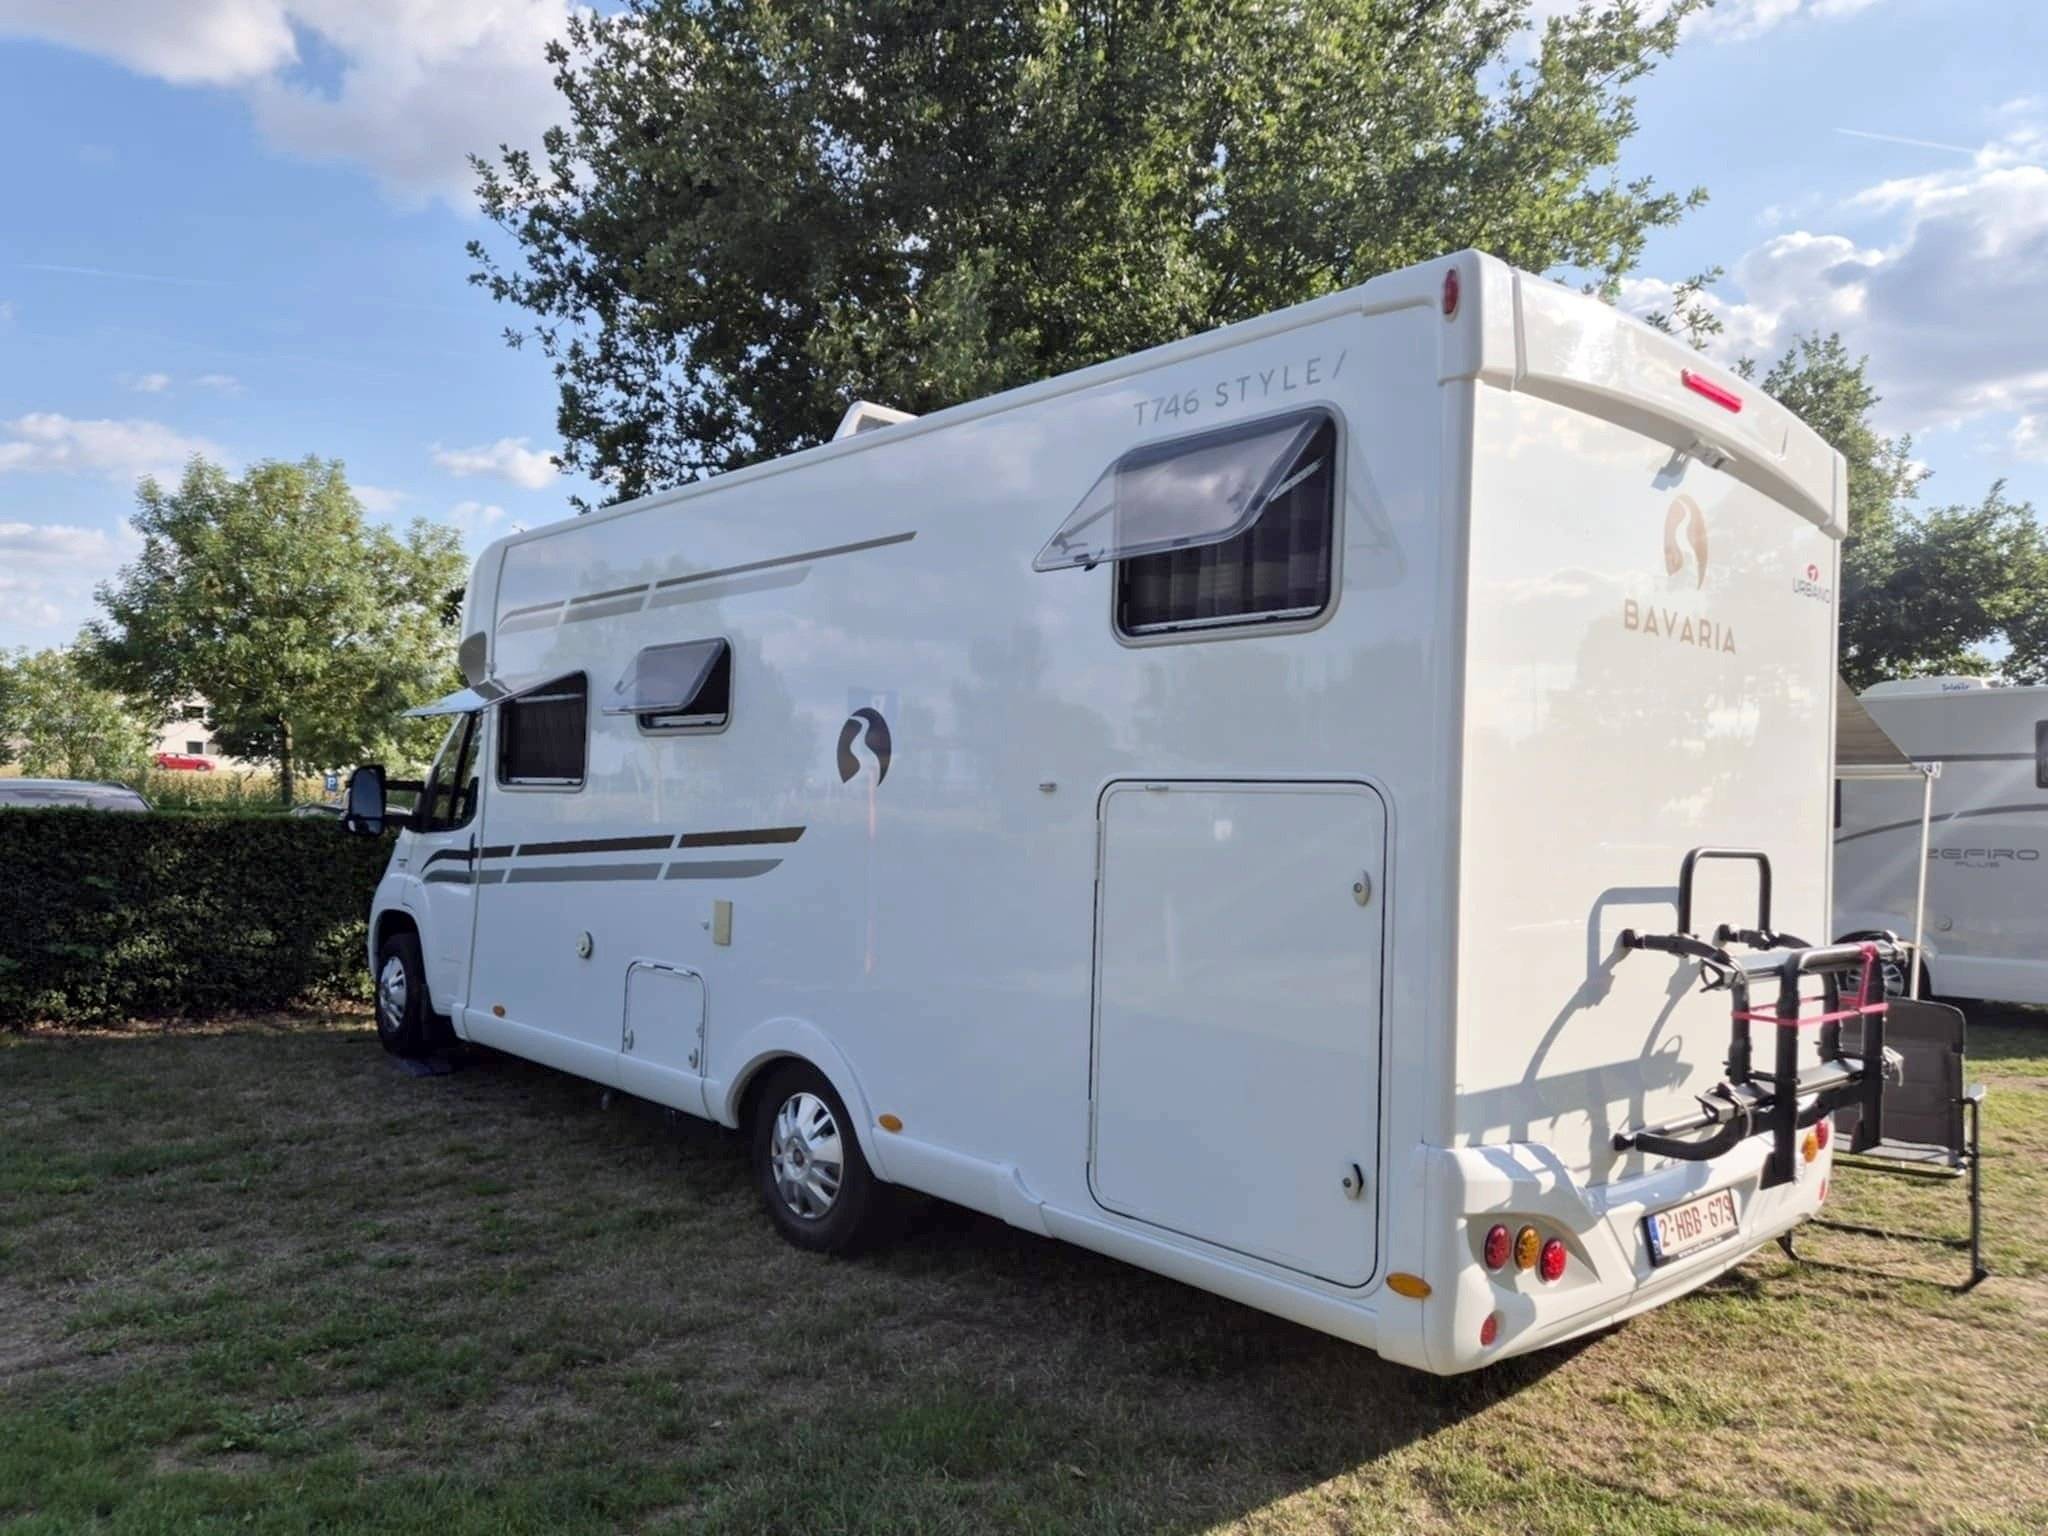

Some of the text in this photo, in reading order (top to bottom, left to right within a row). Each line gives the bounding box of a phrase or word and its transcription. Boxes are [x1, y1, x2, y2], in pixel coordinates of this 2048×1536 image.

[1133, 388, 1200, 426] T746
[1623, 597, 1737, 655] BAVARIA
[1925, 847, 2040, 861] ZEFIRO
[1954, 861, 2001, 869] PLUS
